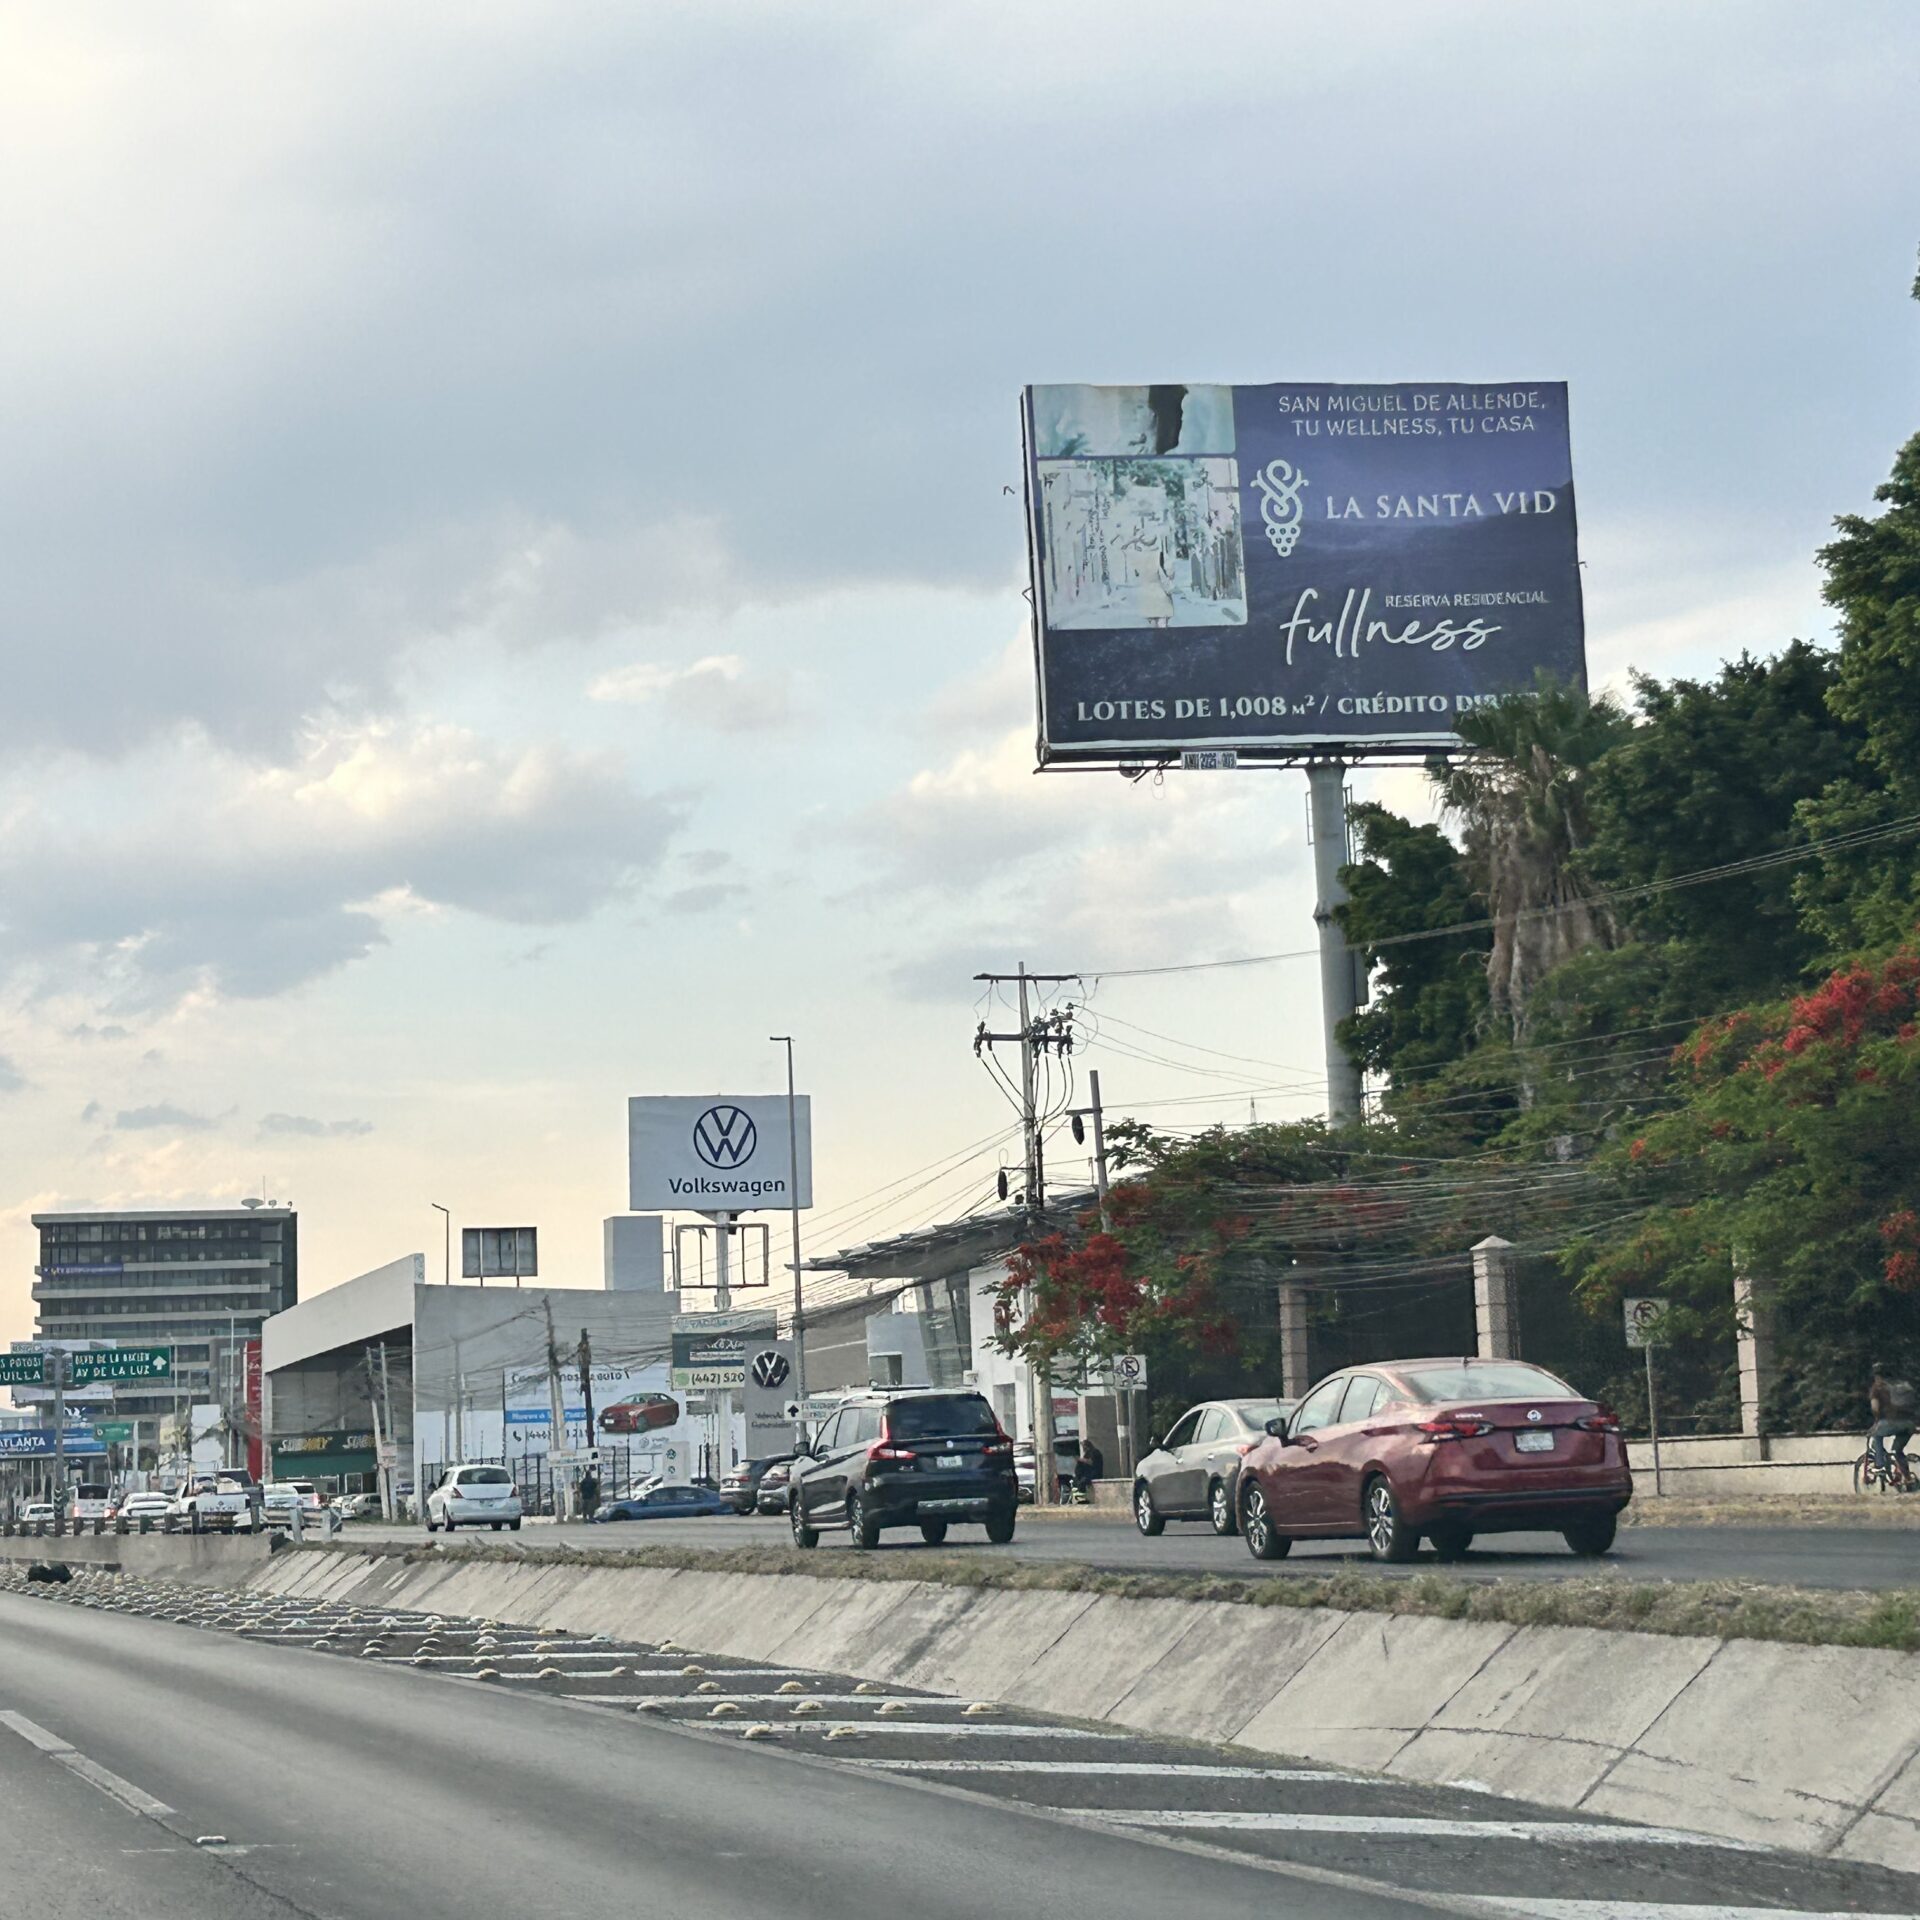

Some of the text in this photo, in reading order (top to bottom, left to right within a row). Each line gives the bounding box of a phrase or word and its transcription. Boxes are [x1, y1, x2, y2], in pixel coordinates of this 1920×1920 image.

[1278, 391, 1545, 413] SAN MIGUEL DE ALLENDE,
[1291, 416, 1535, 436] TU WELLNESS, TU CASA
[1326, 490, 1557, 519] LA SANTA VID
[1385, 590, 1549, 608] RESERVA RESIDENCIAL
[1279, 587, 1503, 666] fullness
[1077, 700, 1167, 721] LOTES
[1175, 698, 1212, 719] DE
[1219, 696, 1287, 720] 1,008
[1337, 691, 1448, 715] CRÉDITO
[668, 1177, 786, 1197] Volkswagen
[111, 1366, 126, 1376] LA
[130, 1364, 150, 1375] LUZ
